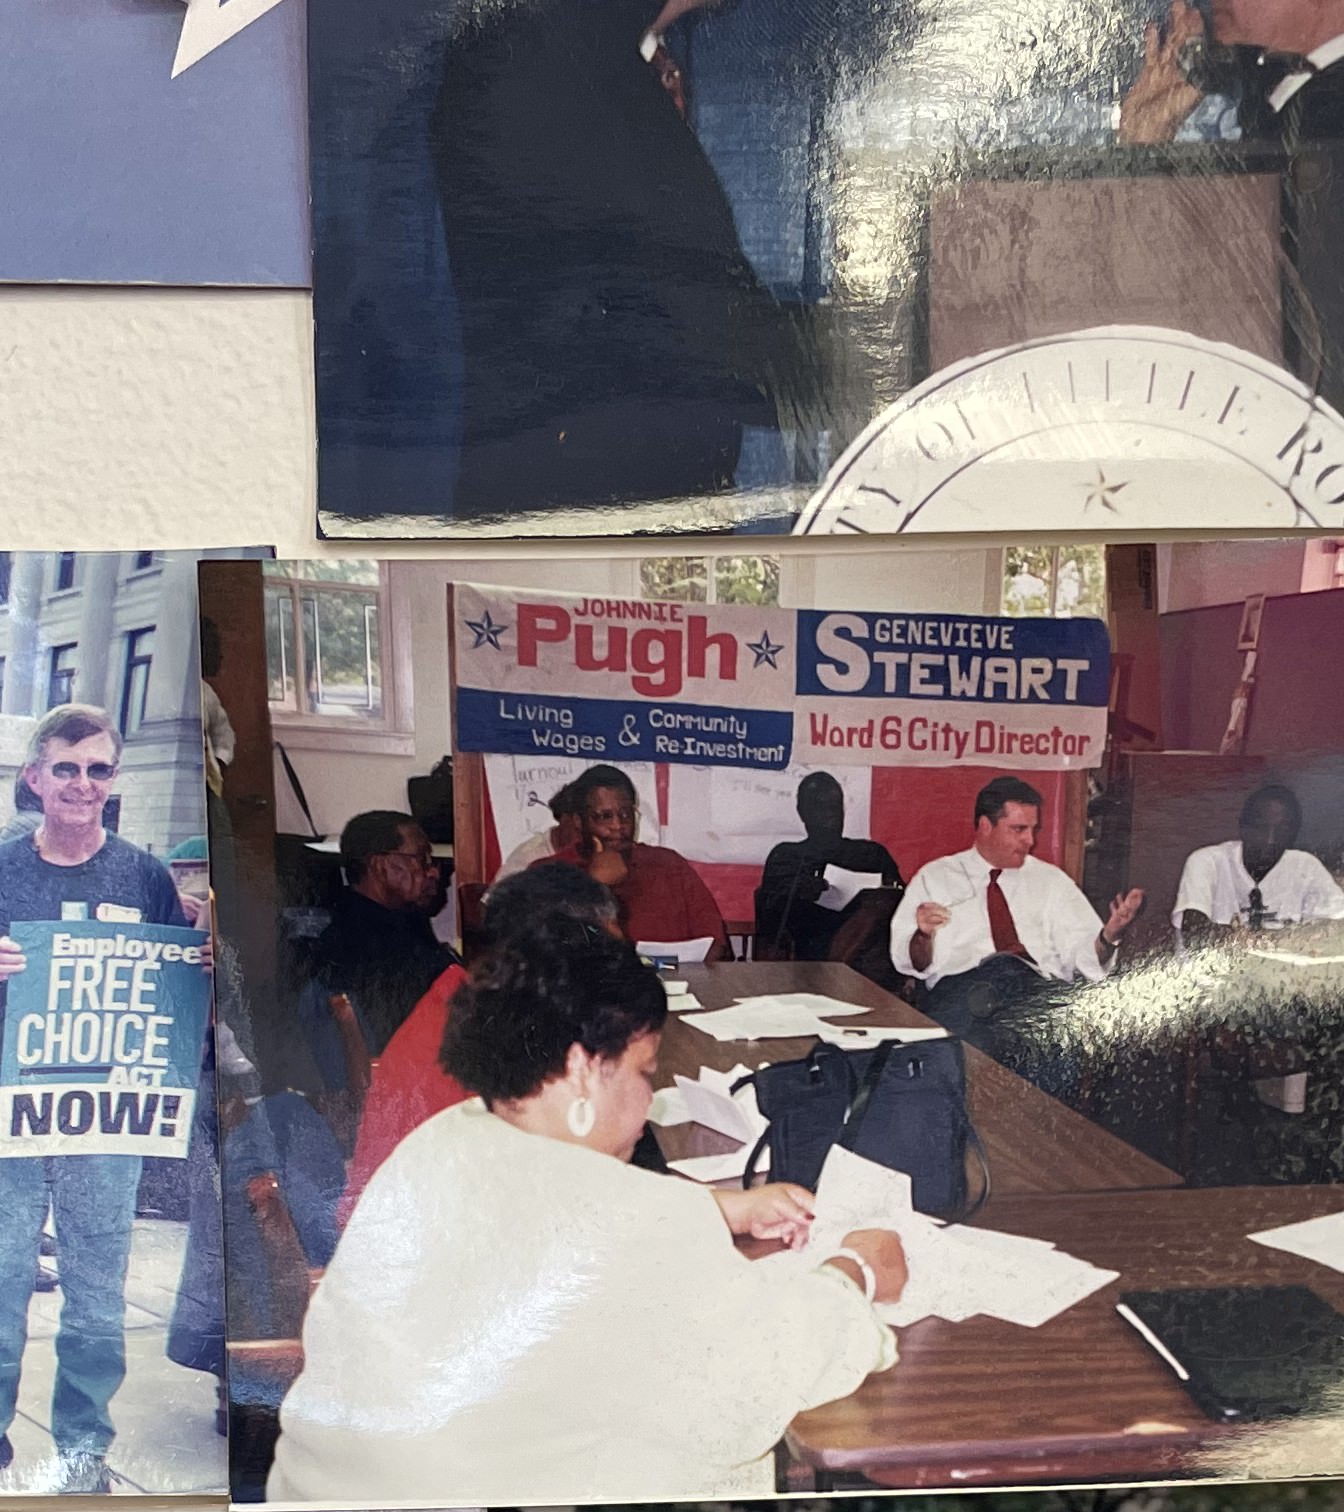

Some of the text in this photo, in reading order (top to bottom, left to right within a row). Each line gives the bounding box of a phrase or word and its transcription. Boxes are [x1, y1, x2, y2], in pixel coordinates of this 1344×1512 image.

[574, 597, 684, 624] JOHNNIE
[516, 602, 739, 697] Pugh
[873, 618, 1015, 650] GENEVIEVE
[815, 613, 1091, 701] STEWART
[499, 698, 574, 729] Living
[648, 708, 748, 738] Community
[531, 713, 641, 752] Wages &
[656, 735, 785, 762] Re-Investment
[809, 712, 1092, 760] Ward 6 City Director
[51, 932, 202, 965] Employee
[47, 957, 162, 1013] FREE
[16, 1012, 175, 1067] CHOICE
[106, 1065, 168, 1088] ACT
[10, 1089, 183, 1138] NOW!
